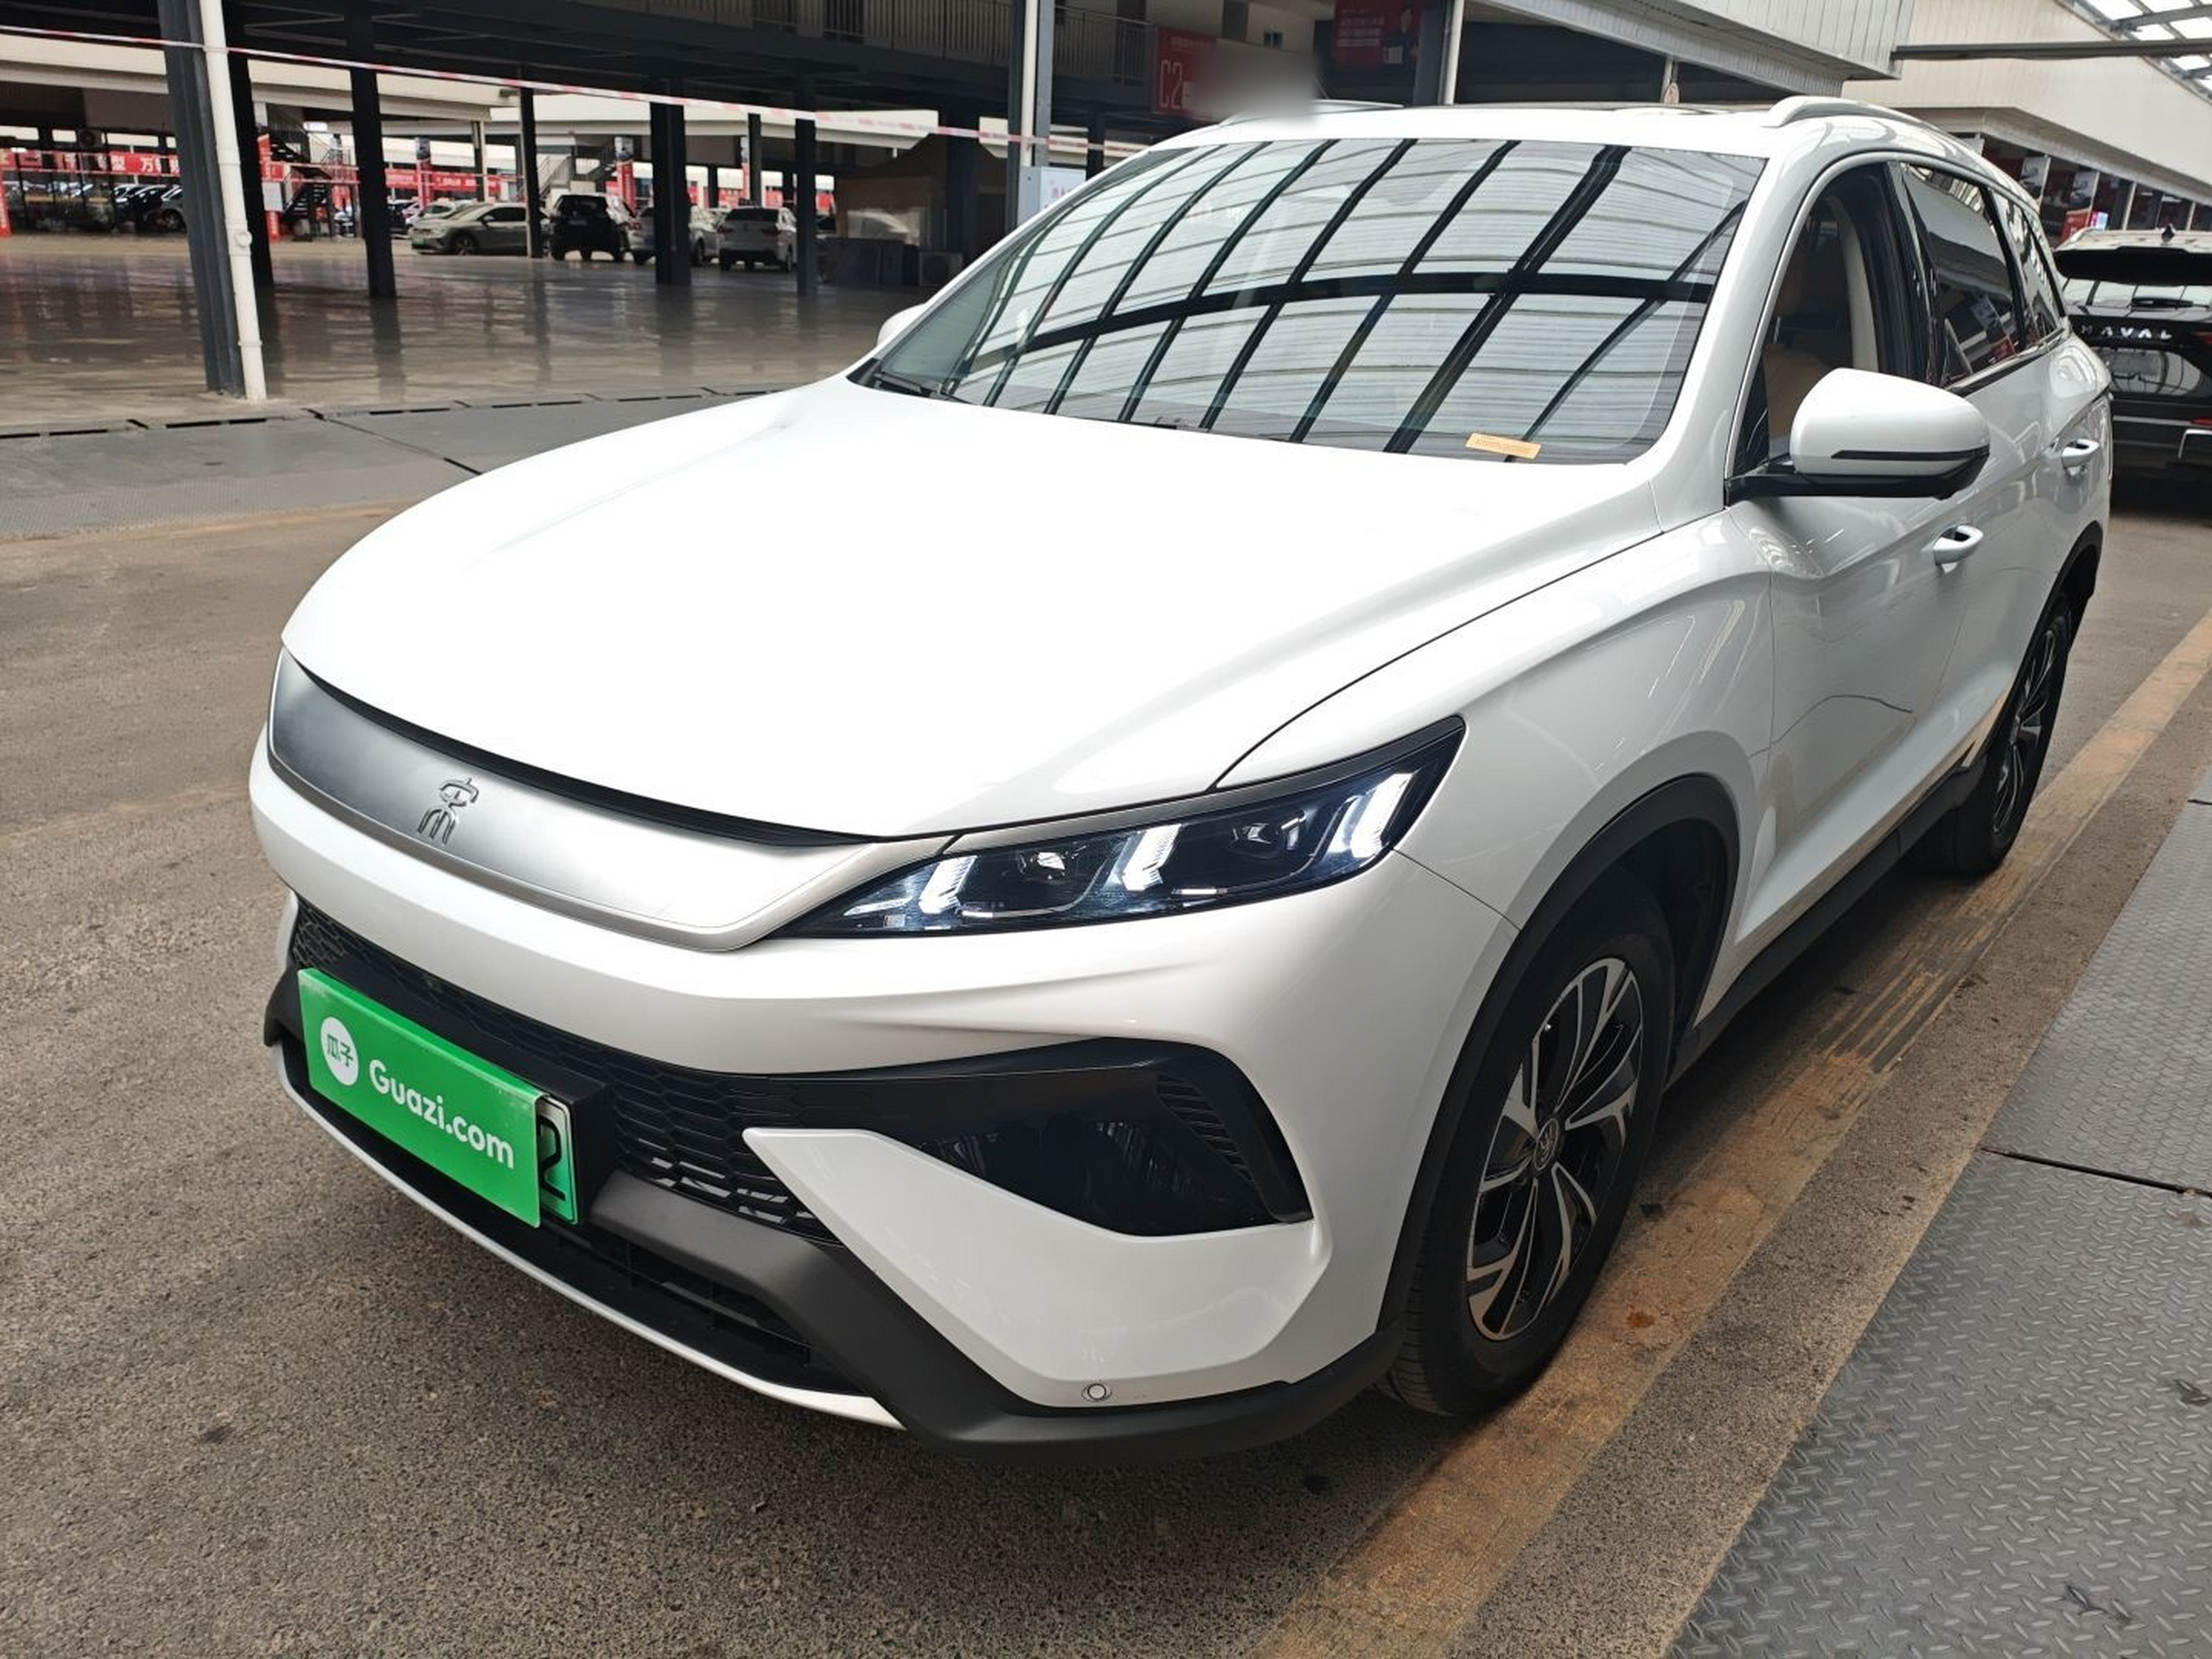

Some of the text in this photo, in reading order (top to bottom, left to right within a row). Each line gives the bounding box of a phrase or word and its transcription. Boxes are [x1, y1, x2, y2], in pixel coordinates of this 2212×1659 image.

[2081, 325, 2172, 339] HAVAL
[327, 1034, 354, 1067] 瓜子
[369, 1060, 514, 1169] Guazi.com
